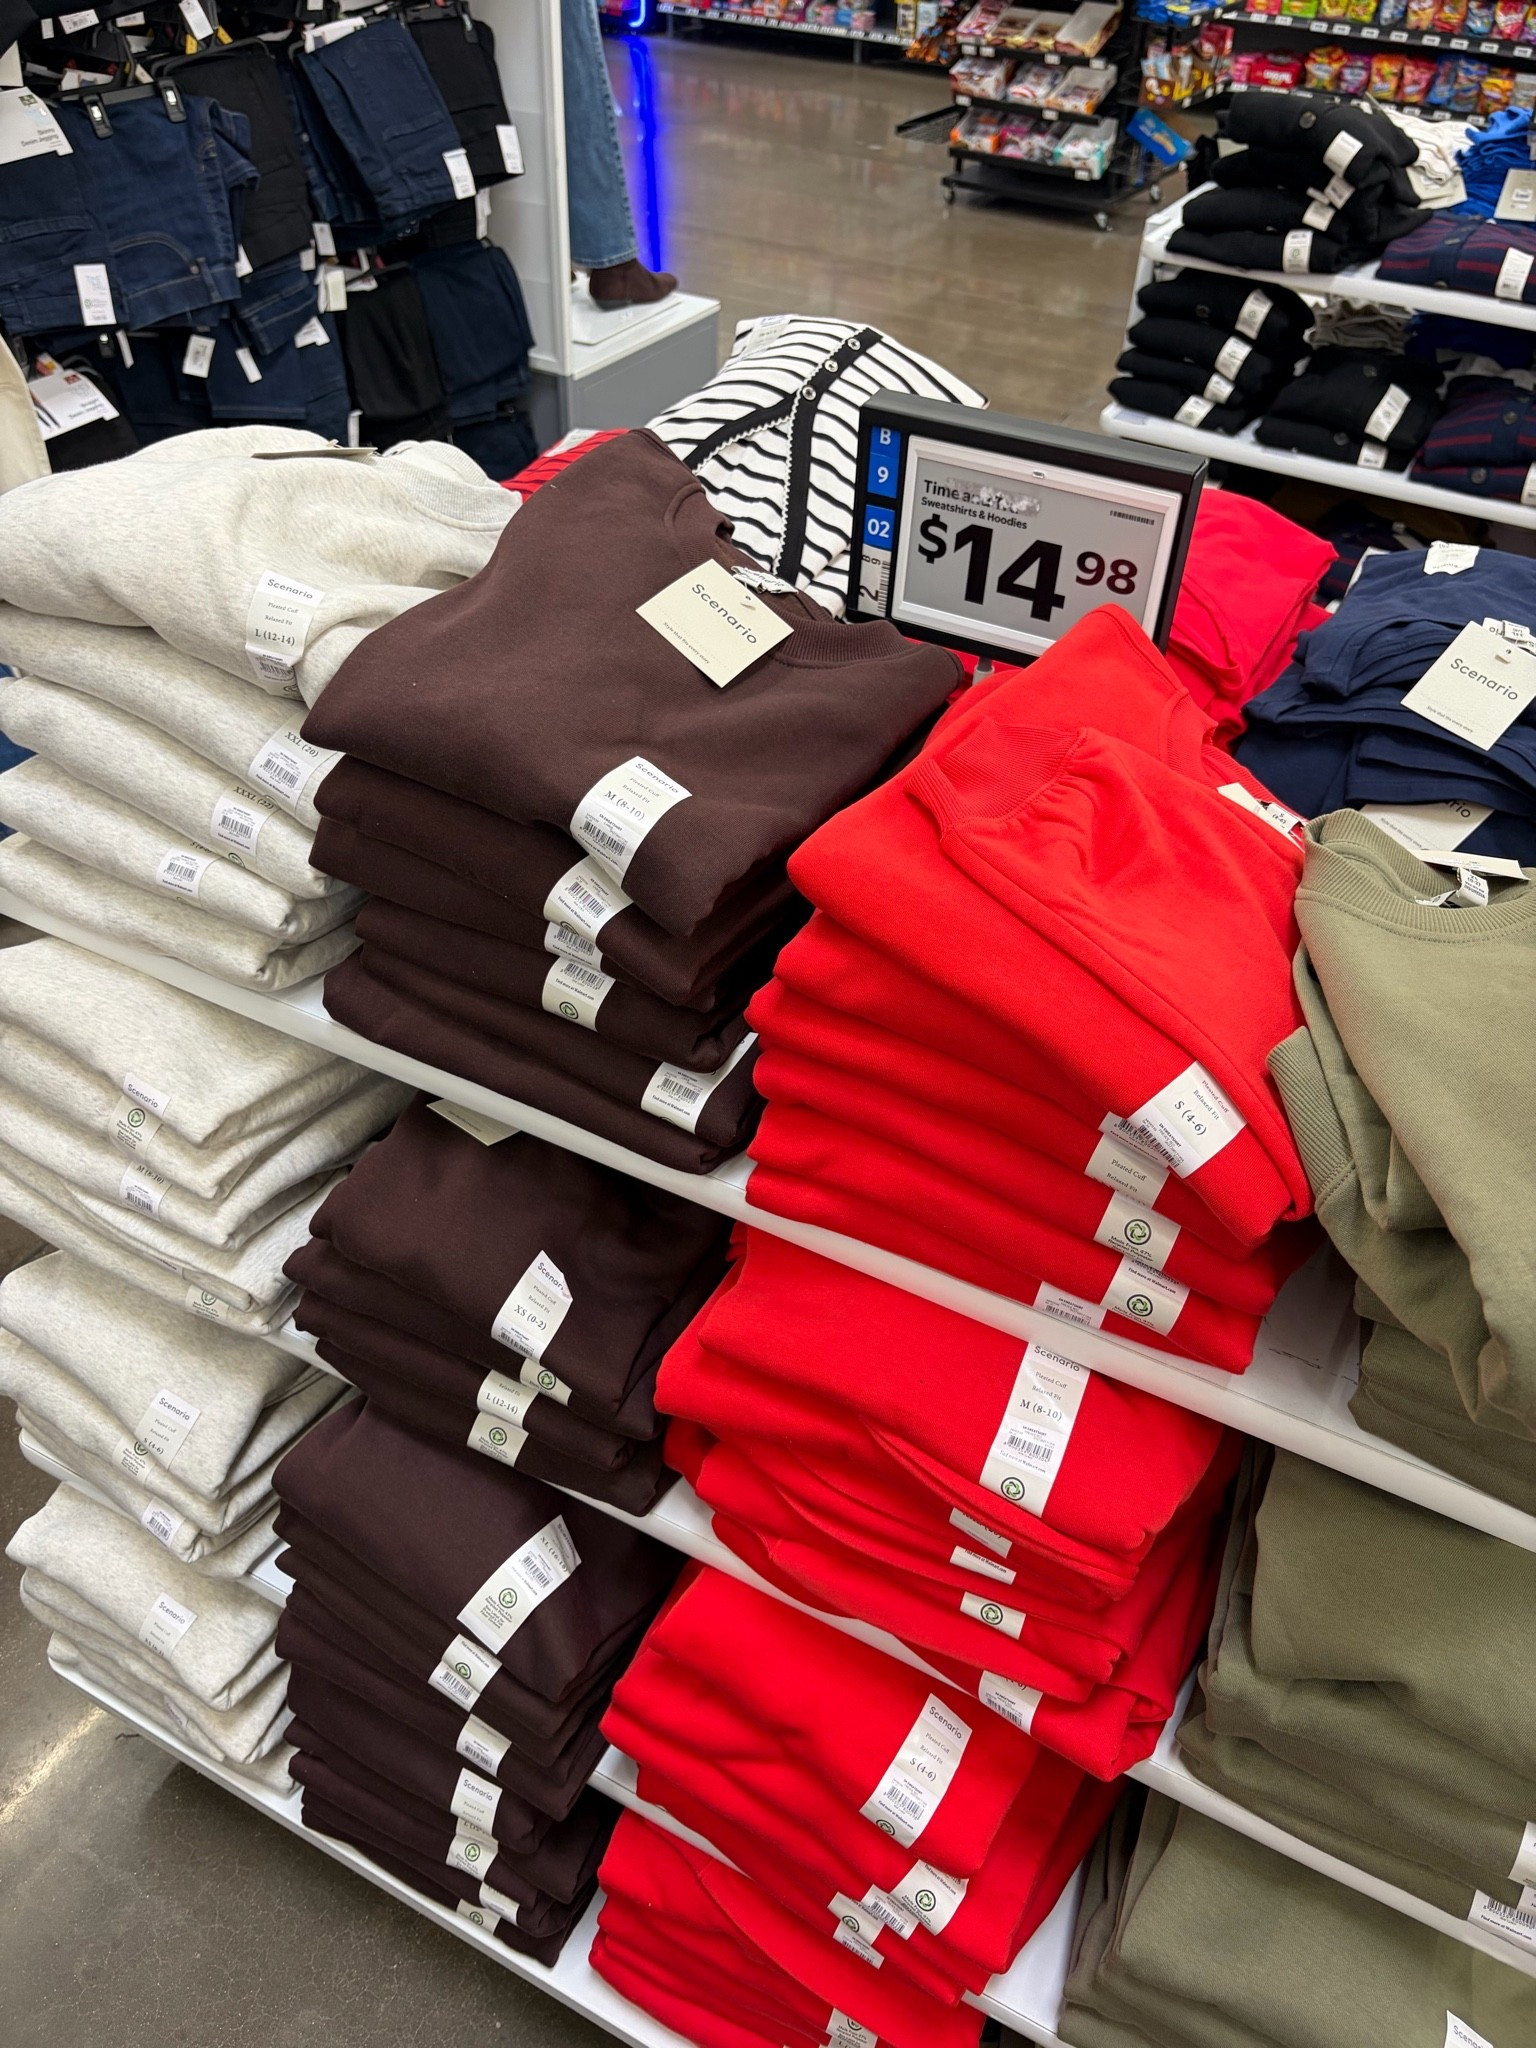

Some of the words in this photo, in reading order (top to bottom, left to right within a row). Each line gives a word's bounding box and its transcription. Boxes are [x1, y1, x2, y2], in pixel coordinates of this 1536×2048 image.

[880, 427, 891, 445] B
[878, 466, 889, 483] 9
[924, 480, 959, 500] Time
[921, 497, 977, 517] Sweatshirts
[987, 513, 1027, 529] Hoodies
[868, 518, 890, 538] 02
[268, 579, 313, 599] Scenario
[268, 602, 286, 611] Pleated
[692, 583, 757, 644] Scenario
[265, 614, 284, 624] Relaxed
[255, 629, 261, 637] L
[264, 631, 295, 646] (12-14)
[664, 622, 674, 632] Style
[674, 631, 682, 640] that
[688, 645, 700, 655] every
[700, 655, 710, 664] story
[1450, 658, 1518, 700] Scenario
[285, 732, 302, 746] XXL
[302, 744, 319, 757] (20)
[635, 763, 679, 794] Scenario
[233, 786, 256, 801] XXXL
[257, 799, 274, 809] (22)
[622, 784, 643, 799] Relaxed
[604, 790, 616, 800] M
[616, 798, 645, 821] (8-10)
[128, 1083, 158, 1109] Scenario
[1193, 1089, 1212, 1112] Relaxed
[1211, 1110, 1220, 1120] Fit
[1202, 1080, 1219, 1100] Pleated
[1218, 1100, 1229, 1113] Cuff
[1174, 1100, 1185, 1110] S
[1182, 1109, 1207, 1136] (4-6)
[136, 1165, 146, 1174] M
[1111, 1159, 1132, 1174] Pleated
[1133, 1171, 1147, 1181] Cuff
[1107, 1172, 1128, 1188] Relaxed
[1130, 1184, 1138, 1193] Fit
[1152, 1279, 1176, 1294] Walmart.com
[514, 1305, 528, 1317] XS
[527, 1313, 547, 1331] (0-2)
[1034, 1345, 1080, 1372] Scenario
[1035, 1371, 1054, 1383] Pleated
[1055, 1379, 1068, 1389] Cuff
[486, 1393, 492, 1401] L
[493, 1397, 519, 1415] (12-14)
[1053, 1392, 1062, 1401] Fit
[159, 1397, 190, 1420] Scenario
[1020, 1399, 1030, 1409] M
[1032, 1403, 1063, 1421] (8-10)
[541, 1536, 549, 1547] XL
[159, 1601, 185, 1624] Scenario
[929, 1706, 962, 1739] Scenario
[925, 1732, 941, 1748] Pleated
[920, 1744, 937, 1761] Relaxed
[909, 1757, 916, 1766] S
[917, 1762, 937, 1782] (4-6)
[463, 1779, 493, 1801] Scenario
[1506, 1926, 1532, 1940] Walmart.com
